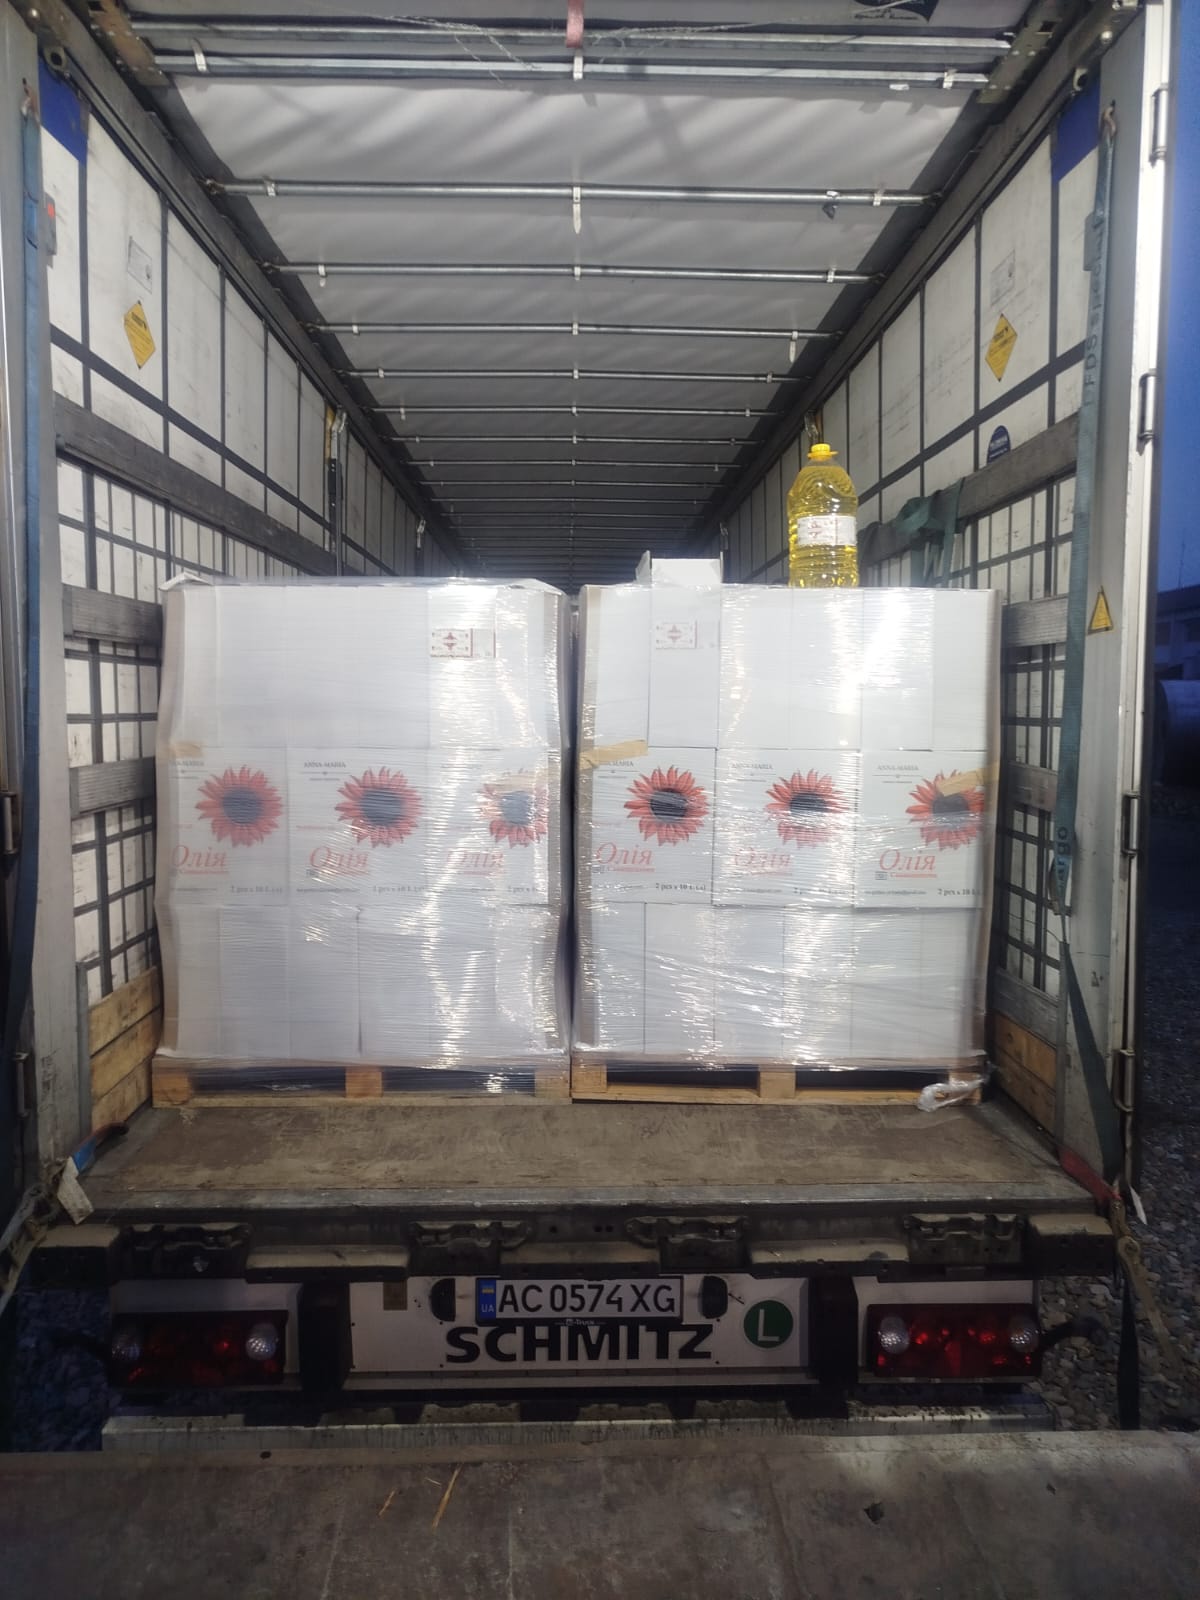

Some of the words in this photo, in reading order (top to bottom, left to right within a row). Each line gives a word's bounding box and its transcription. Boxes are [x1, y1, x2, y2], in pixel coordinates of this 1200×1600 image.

[171, 844, 229, 868] Олія
[595, 841, 654, 866] Олія
[879, 848, 937, 871] Олія
[481, 1305, 495, 1313] UA
[499, 1284, 543, 1313] AC
[550, 1284, 623, 1313] 0574
[630, 1284, 676, 1313] XG
[757, 1308, 781, 1342] L
[446, 1324, 714, 1363] SCHMITZ
